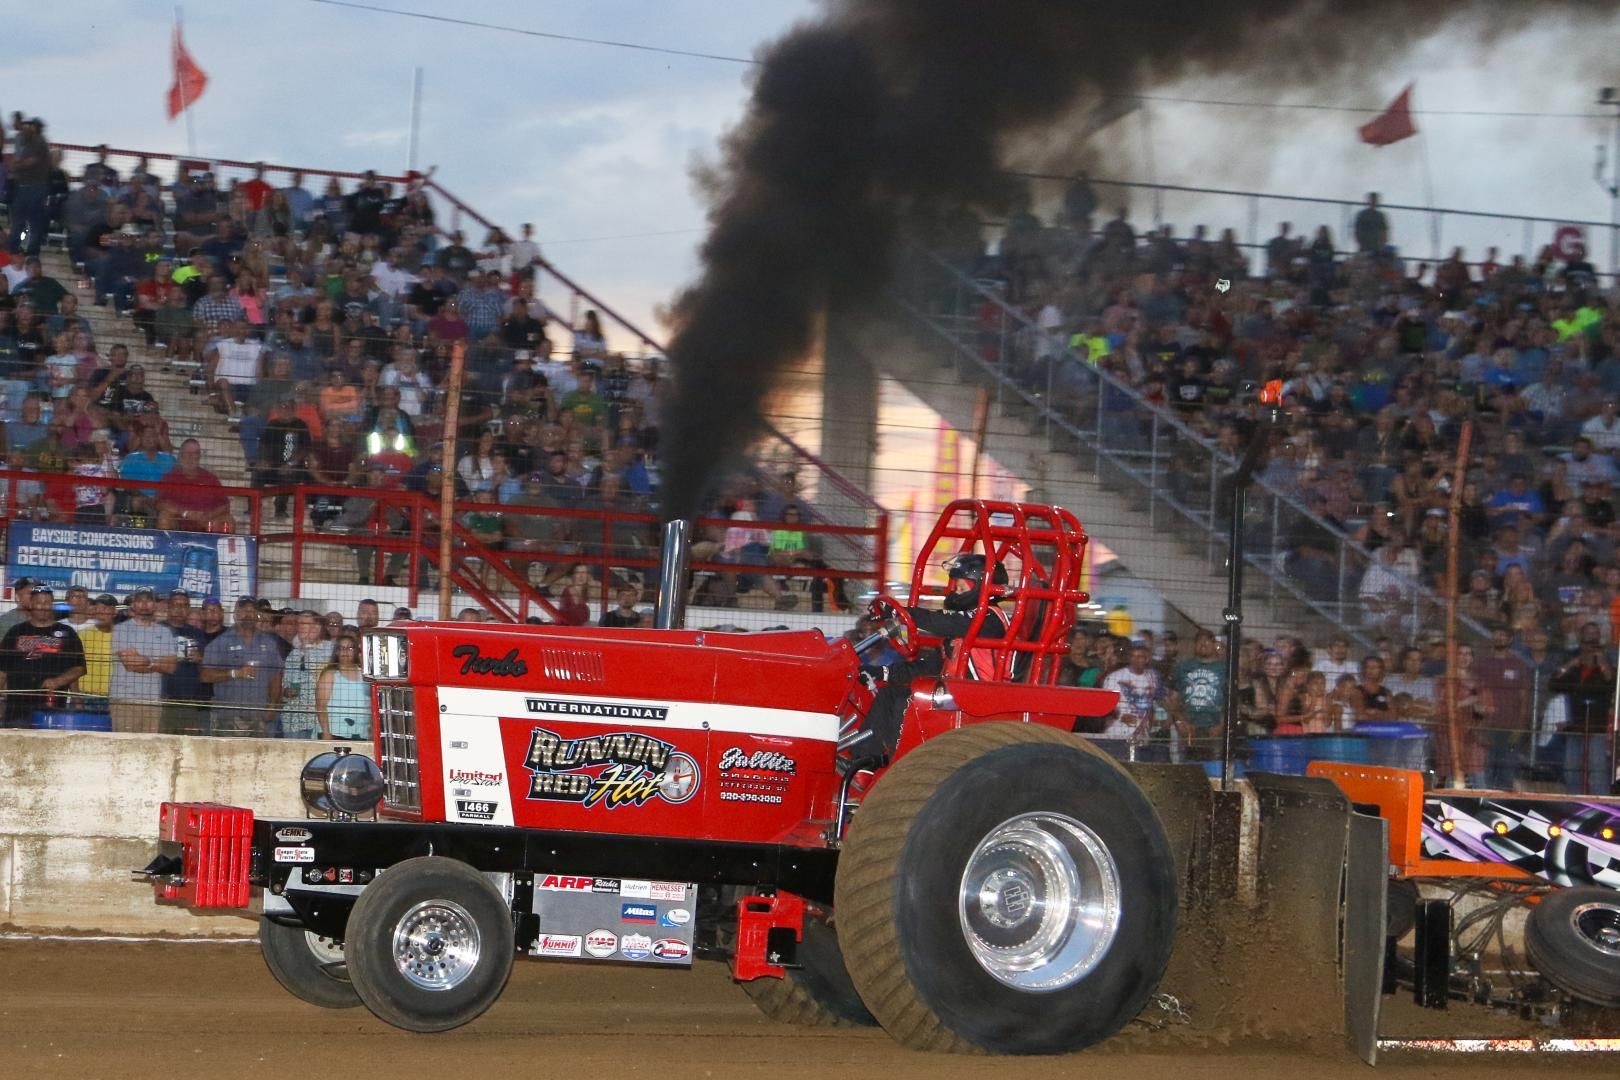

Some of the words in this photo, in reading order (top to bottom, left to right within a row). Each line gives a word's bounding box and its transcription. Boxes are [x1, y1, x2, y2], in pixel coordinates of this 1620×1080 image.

[31, 528, 78, 545] BAYSIDE
[79, 531, 155, 549] CONCESSIONS
[17, 545, 97, 570] BEVERAGE
[98, 550, 165, 573] WINDOW
[71, 570, 110, 591] ONLY
[453, 644, 529, 678] Turbo
[530, 700, 665, 719] INTERNATIONAL
[528, 729, 673, 771] RUNNIN
[449, 768, 503, 781] Limited
[531, 772, 591, 798] RED
[584, 763, 666, 804] Hot
[464, 802, 490, 813] 1466
[281, 827, 308, 837] LEMKE
[542, 875, 594, 890] ARP
[594, 879, 619, 888] Ritchie
[651, 883, 685, 893] HENNESSEY
